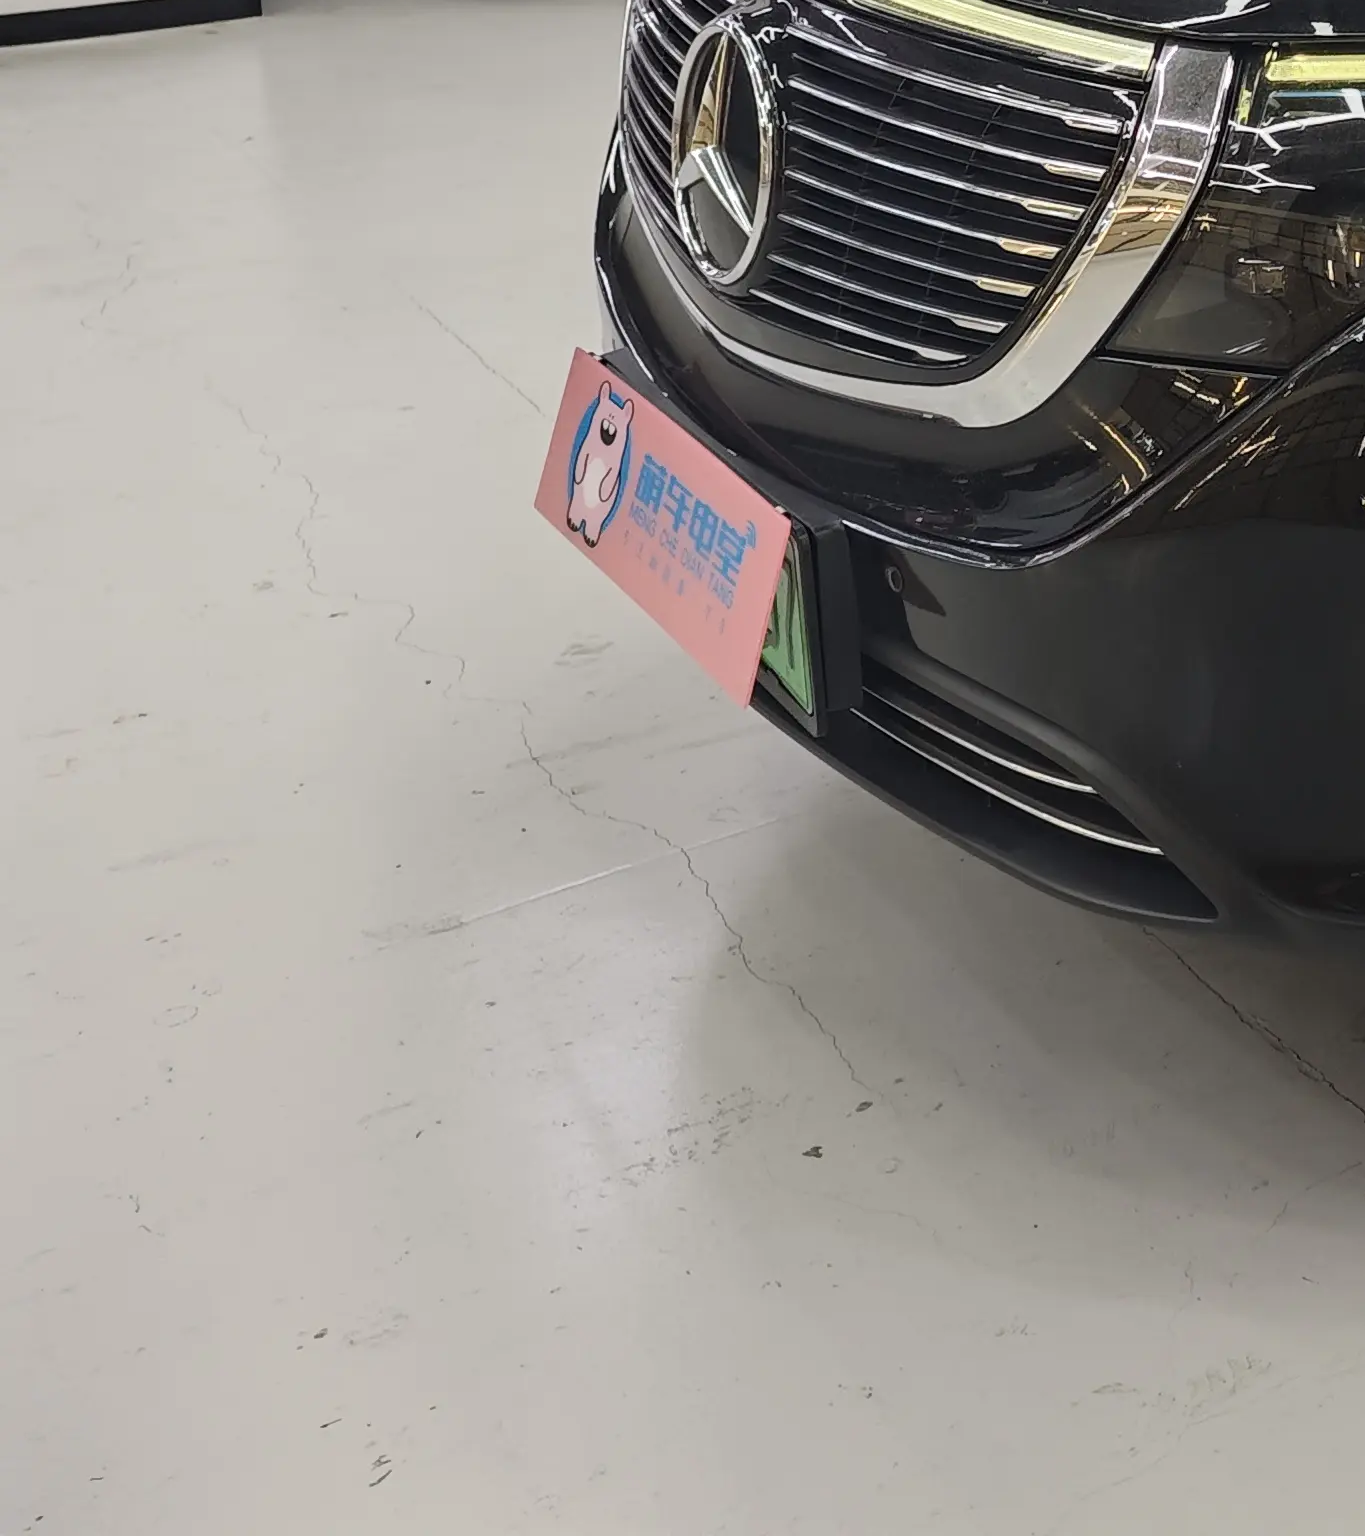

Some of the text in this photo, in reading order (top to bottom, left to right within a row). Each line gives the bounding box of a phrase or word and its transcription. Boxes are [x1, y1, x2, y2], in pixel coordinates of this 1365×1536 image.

[629, 501, 734, 609] MENG CHE DIAN TANG
[635, 453, 747, 587] 萌车电堂
